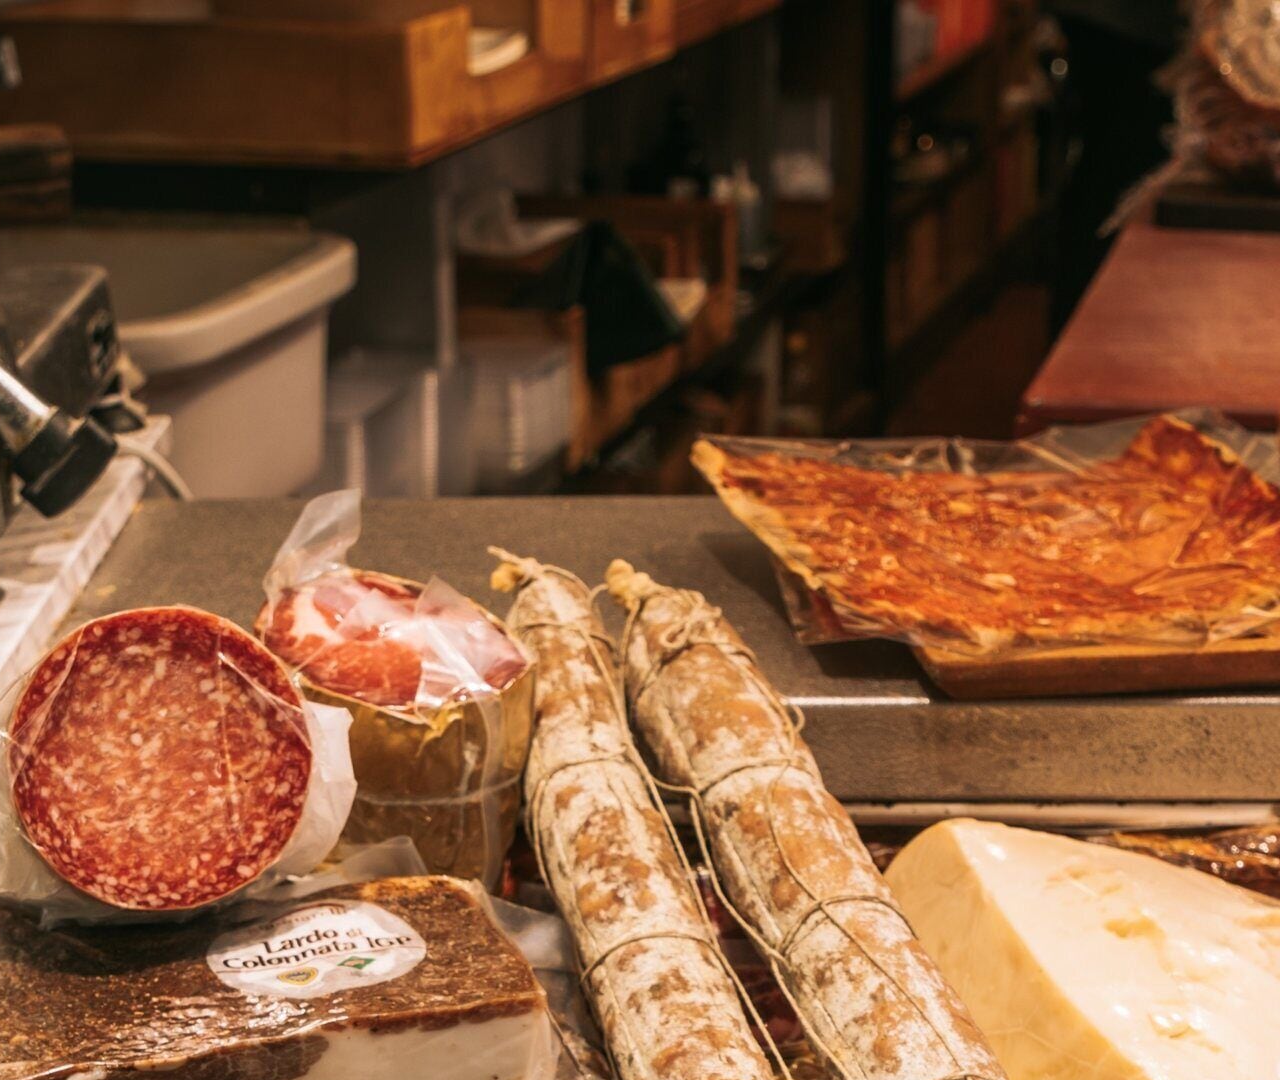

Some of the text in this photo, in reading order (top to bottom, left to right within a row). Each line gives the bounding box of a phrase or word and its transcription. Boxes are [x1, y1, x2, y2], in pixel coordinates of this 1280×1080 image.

[222, 935, 414, 969] Colonnata IGP
[262, 927, 363, 955] Lardo di
